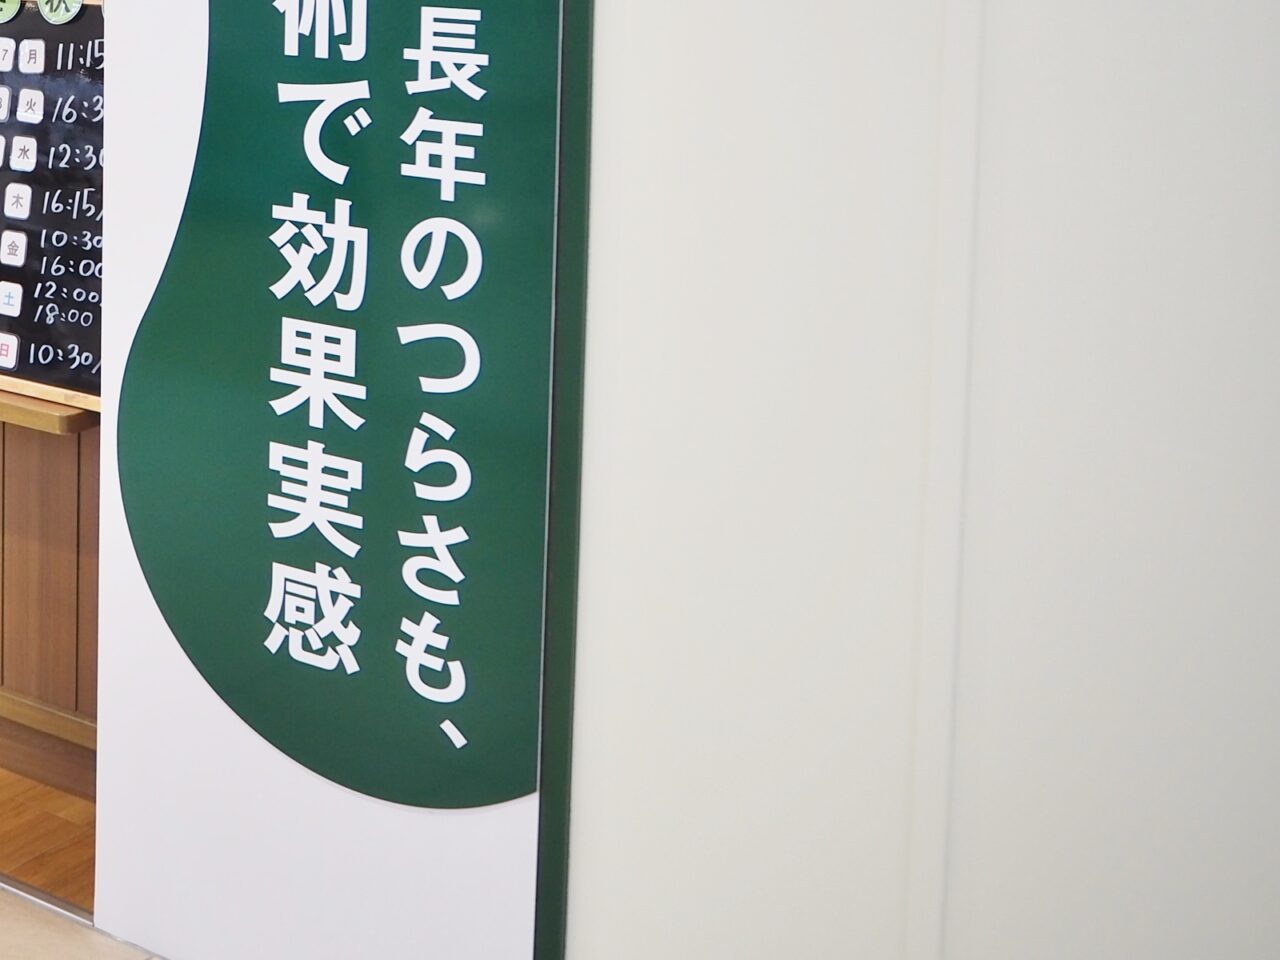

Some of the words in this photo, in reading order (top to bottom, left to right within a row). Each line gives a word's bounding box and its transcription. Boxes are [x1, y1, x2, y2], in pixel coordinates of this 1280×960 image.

[27, 49, 38, 65] 月
[24, 98, 37, 114] 火
[17, 144, 30, 160] 水
[11, 193, 24, 209] 木
[7, 240, 19, 257] 金
[2, 291, 15, 307] 土
[33, 302, 94, 327] 18:00
[0, 343, 10, 358] 日
